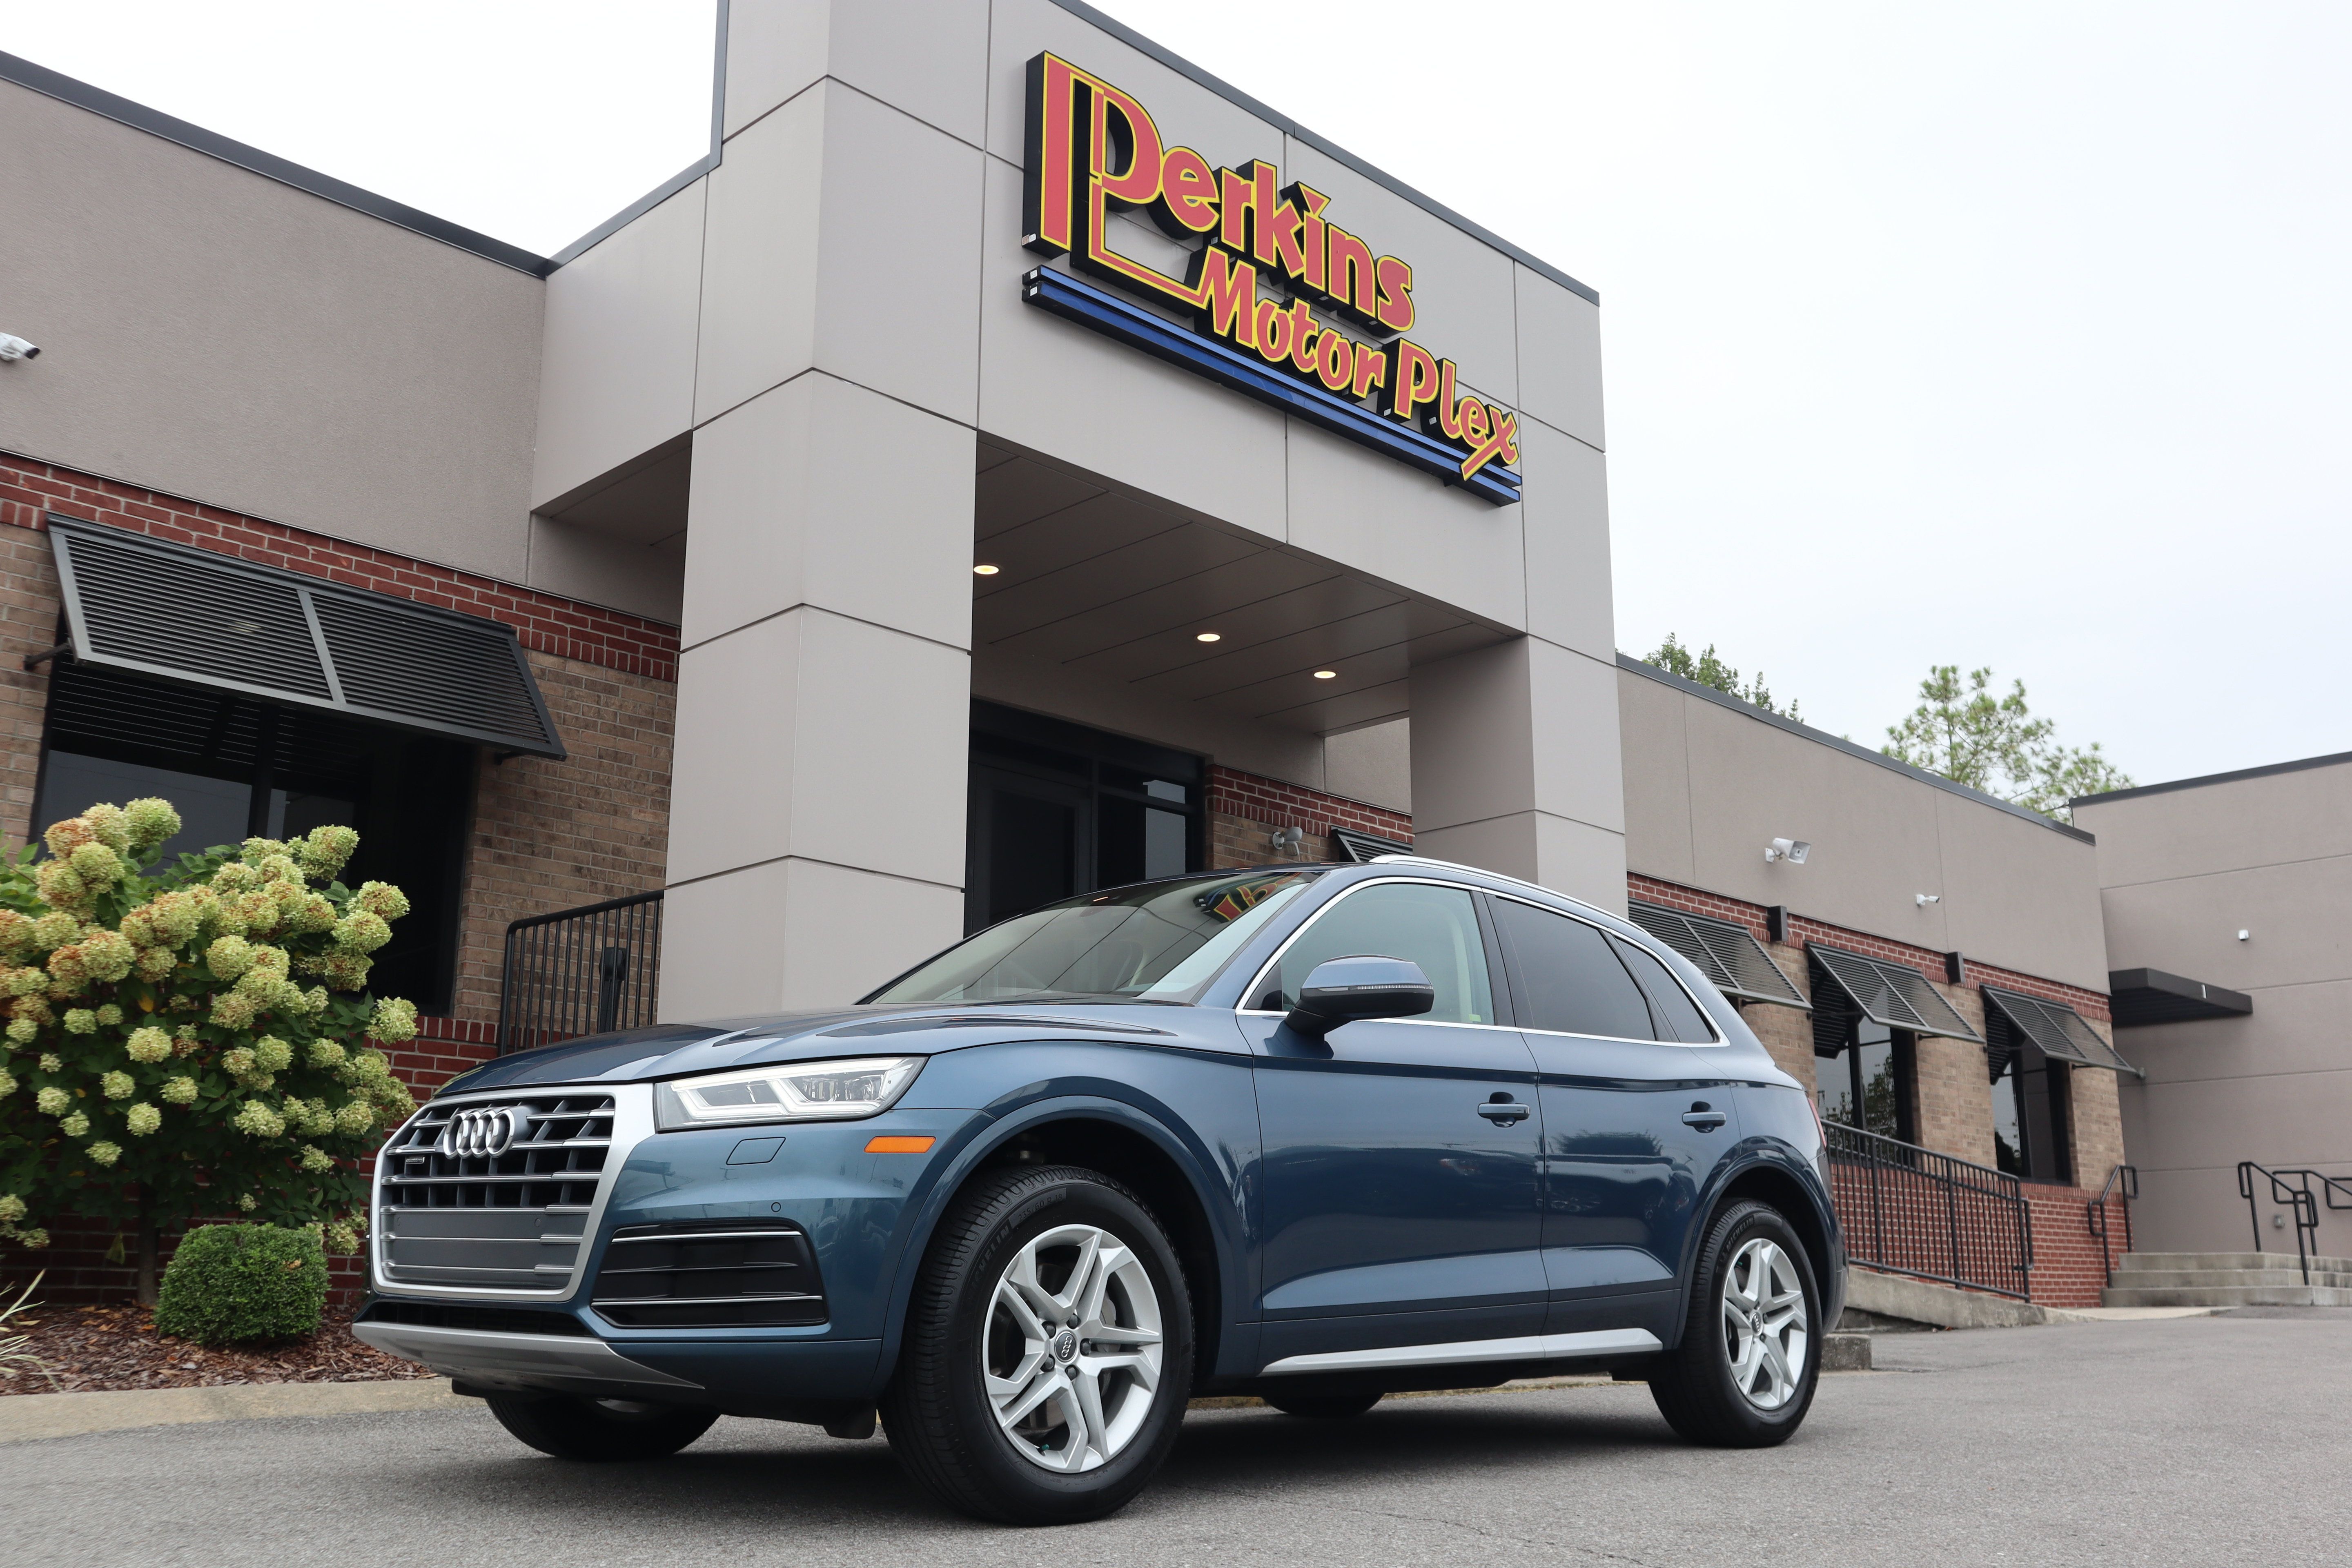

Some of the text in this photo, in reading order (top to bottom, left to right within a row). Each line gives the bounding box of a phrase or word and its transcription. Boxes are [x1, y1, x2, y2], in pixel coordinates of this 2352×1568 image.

[1039, 50, 1416, 332] Perkins
[1198, 245, 1520, 481] Motor Plex
[1018, 1200, 1044, 1223] 235/60
[1055, 1194, 1062, 1202] 18
[1726, 1217, 1753, 1253] MICHELIN
[969, 1225, 1010, 1297] ICHELIN
